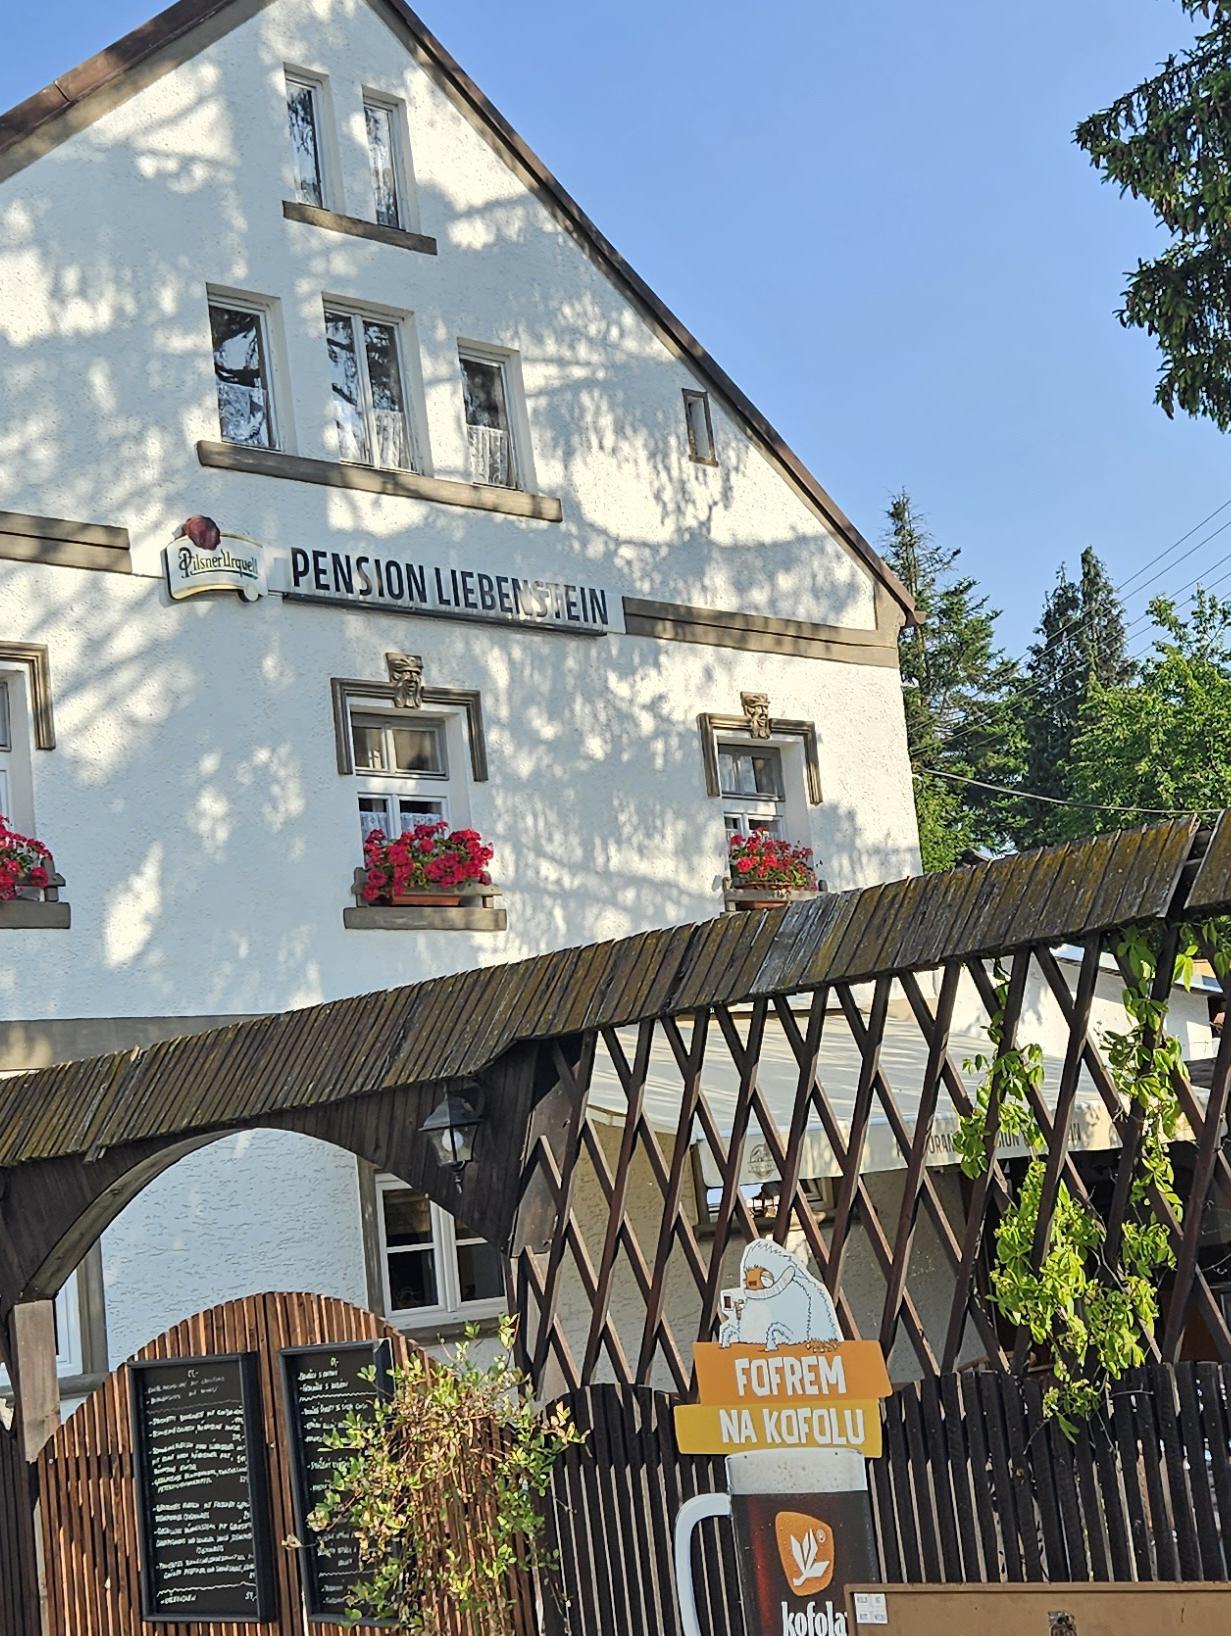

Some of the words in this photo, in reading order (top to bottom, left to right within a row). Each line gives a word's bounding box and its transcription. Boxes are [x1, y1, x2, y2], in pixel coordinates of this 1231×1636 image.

[178, 546, 222, 579] Pilsner
[221, 548, 258, 578] Urquell
[290, 547, 427, 604] PENSION
[434, 566, 610, 626] LIEBENSTEIN
[734, 1355, 847, 1397] FOFREM
[719, 1409, 758, 1444] NA
[762, 1407, 866, 1445] KOFOLU
[781, 1601, 848, 1636] kofola
